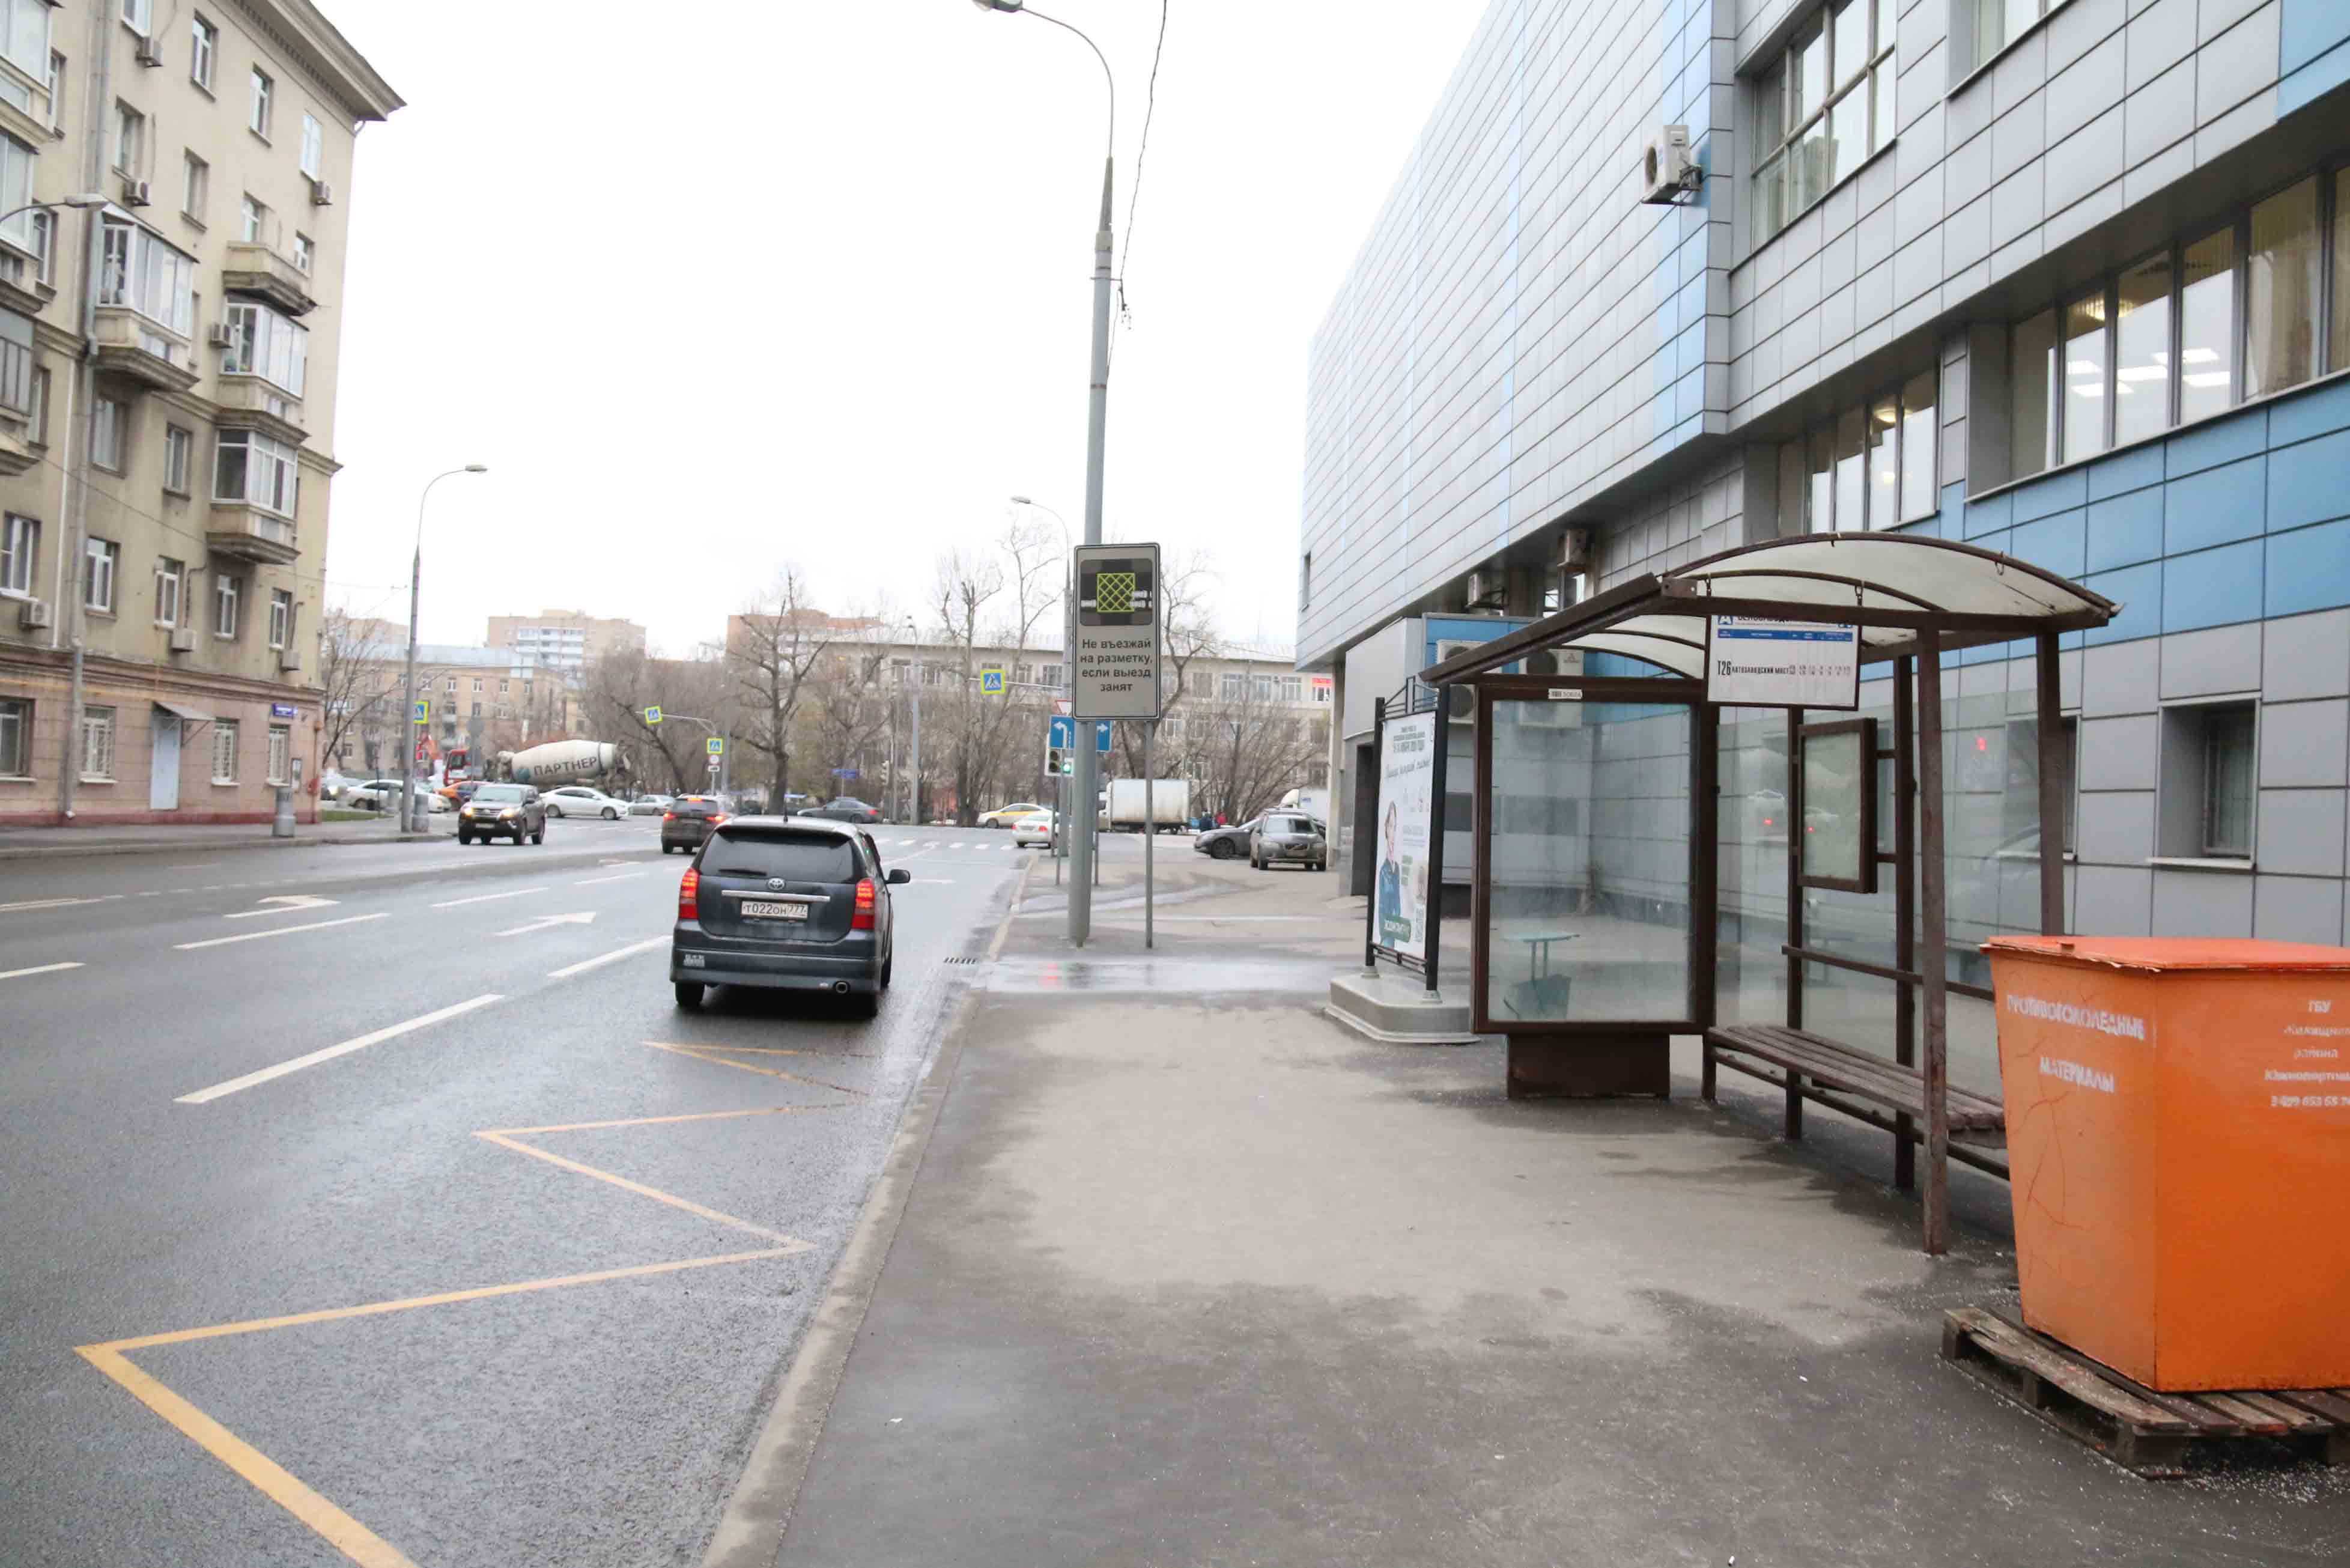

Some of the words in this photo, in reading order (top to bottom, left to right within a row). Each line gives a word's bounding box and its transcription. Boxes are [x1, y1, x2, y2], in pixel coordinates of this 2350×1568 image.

[1082, 639, 1096, 649] Не
[1101, 637, 1152, 649] въезжай
[1081, 669, 1110, 678] если
[1113, 669, 1152, 678] выезд
[1100, 683, 1134, 692] занят
[533, 756, 597, 776] ПАРТНЕР
[2039, 1057, 2115, 1093] МАТЕРИАЛЫ
